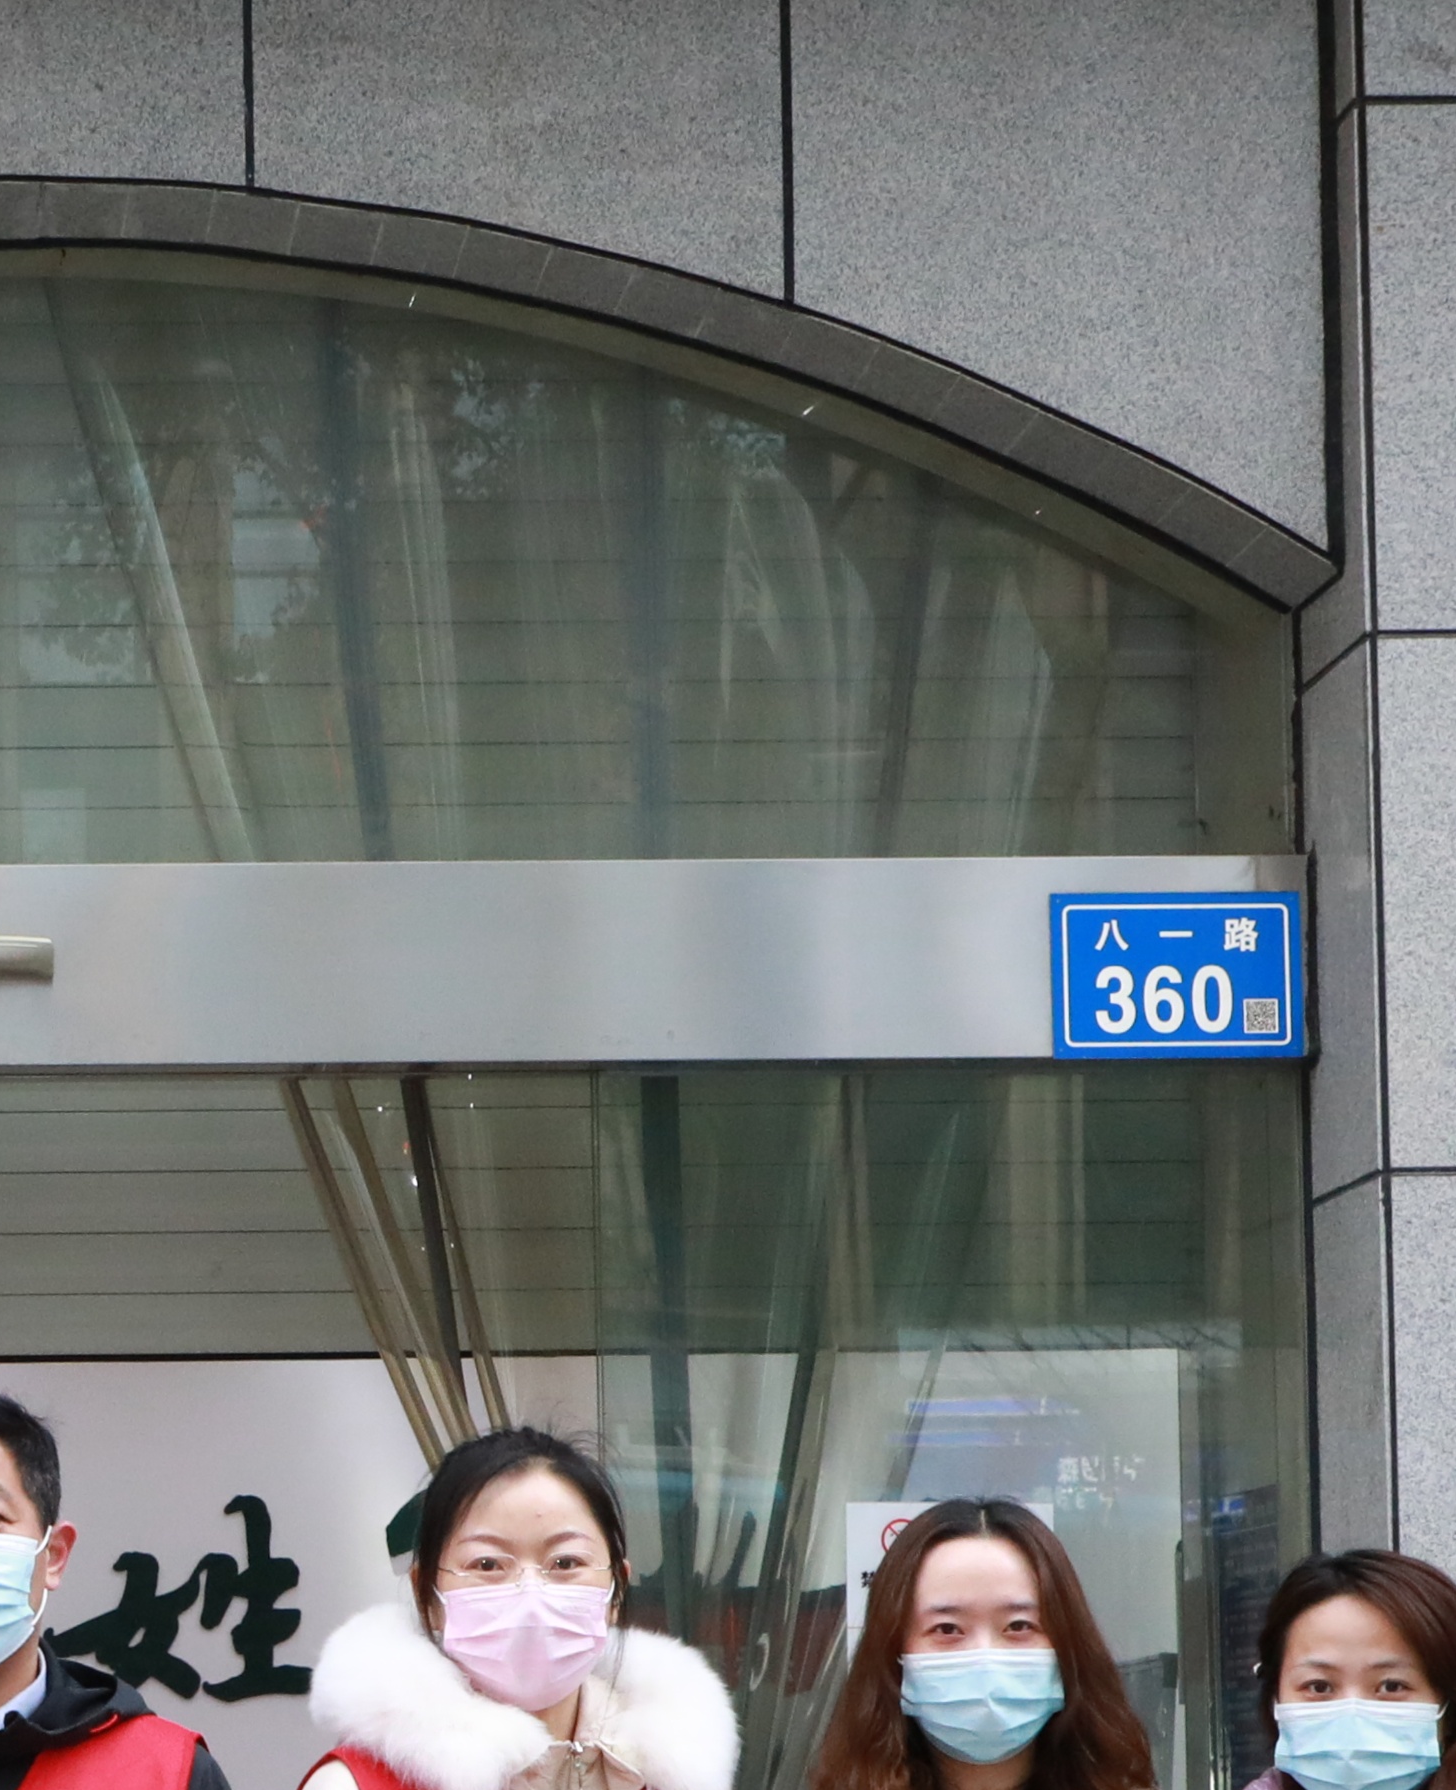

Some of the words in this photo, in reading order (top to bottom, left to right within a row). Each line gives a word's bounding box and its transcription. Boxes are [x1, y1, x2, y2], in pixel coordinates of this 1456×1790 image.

[1095, 917, 1259, 952] 八一路
[1094, 964, 1233, 1034] 360
